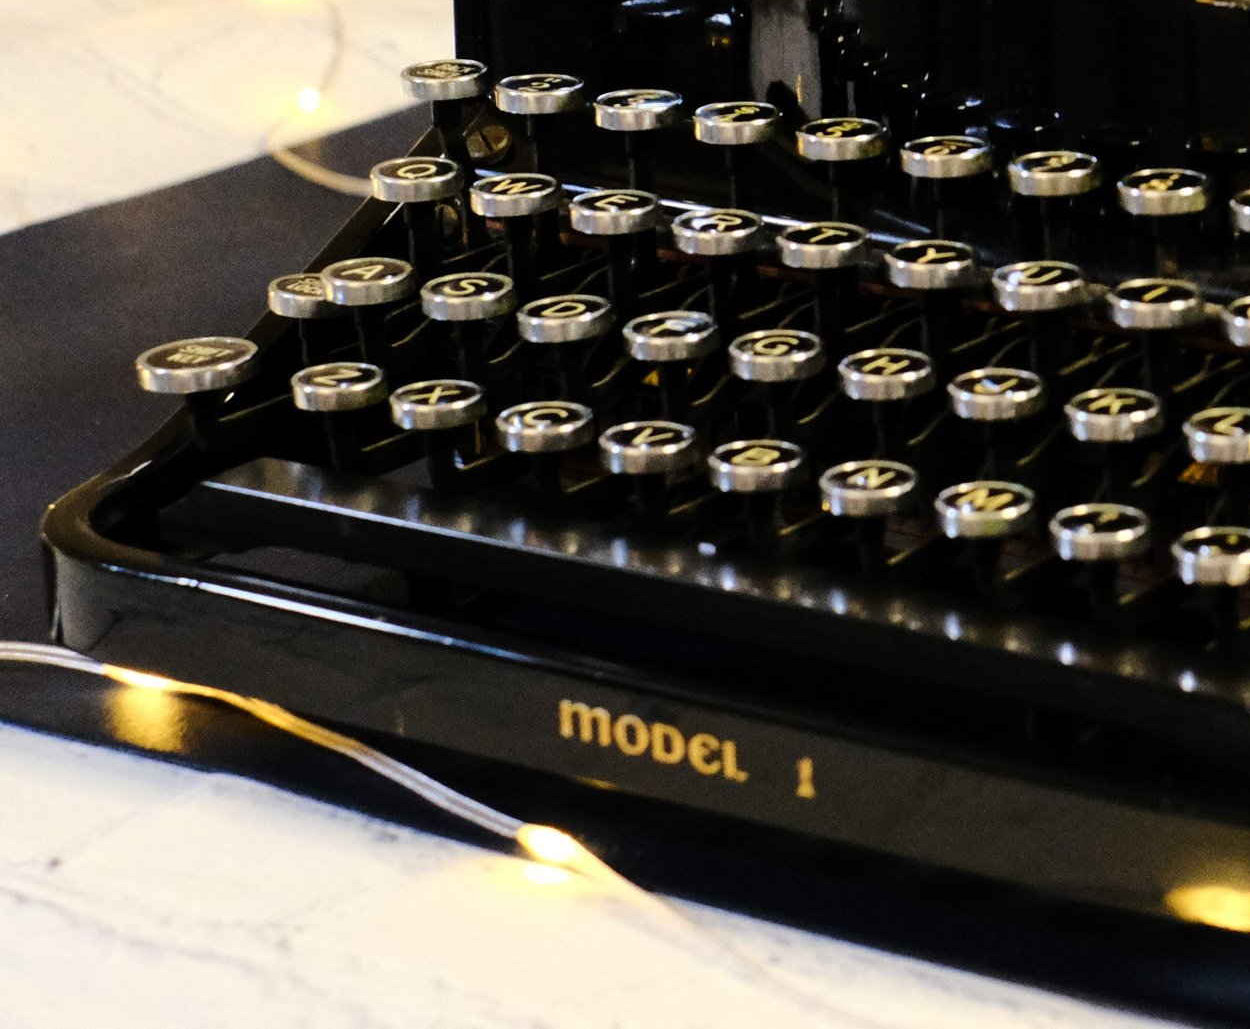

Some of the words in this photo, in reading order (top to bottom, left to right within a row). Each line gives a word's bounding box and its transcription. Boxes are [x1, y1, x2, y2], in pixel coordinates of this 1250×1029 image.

[397, 163, 437, 179] Q
[490, 178, 542, 194] W
[594, 194, 639, 213] E
[692, 214, 742, 231] R
[809, 227, 849, 243] T
[340, 264, 385, 280] A
[1018, 266, 1062, 284] U
[442, 278, 489, 296] S
[541, 301, 587, 318] D
[649, 319, 698, 335] F
[754, 336, 799, 356] G
[860, 355, 911, 375] H
[312, 368, 363, 385] Z
[408, 386, 461, 404] X
[1088, 394, 1137, 415] K
[523, 408, 569, 427] C
[631, 427, 674, 446] V
[731, 447, 781, 466] B
[846, 468, 896, 489] N
[955, 488, 1014, 511] M
[558, 698, 749, 783] MODEL
